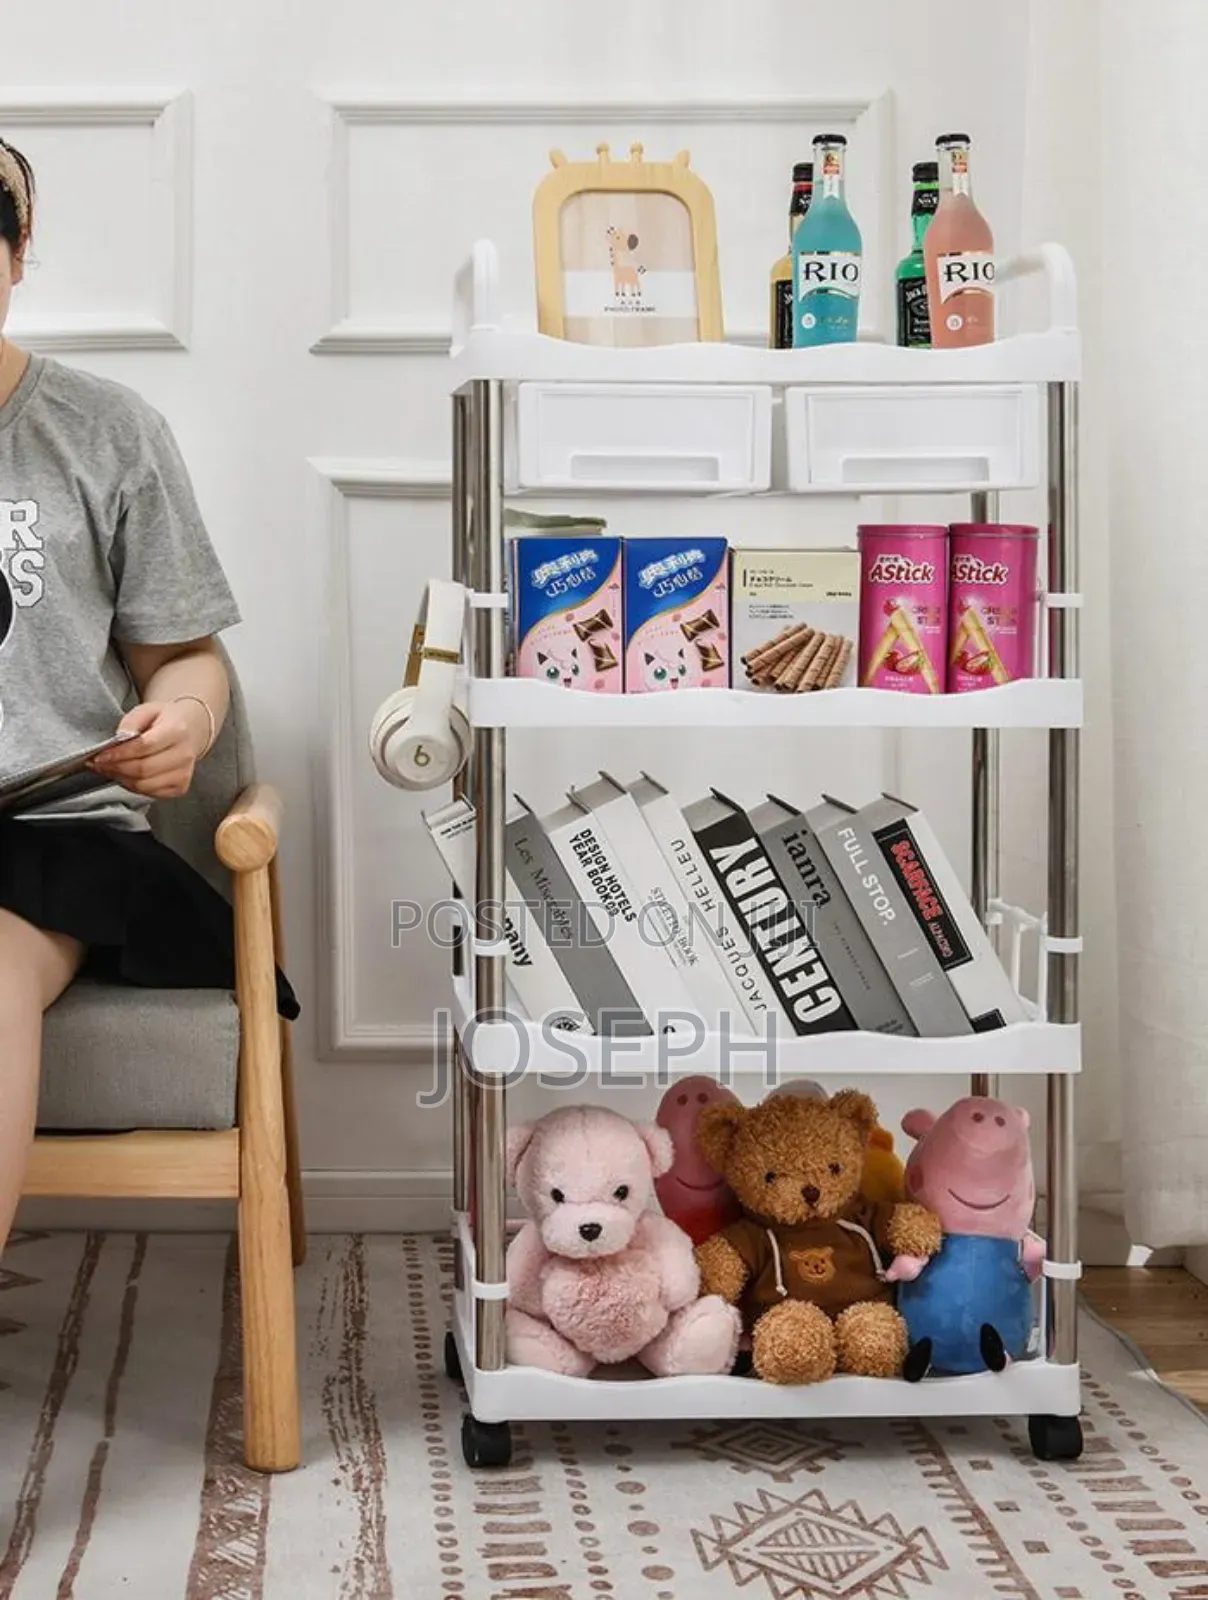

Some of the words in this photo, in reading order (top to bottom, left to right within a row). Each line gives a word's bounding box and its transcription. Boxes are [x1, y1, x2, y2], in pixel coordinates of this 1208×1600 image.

[803, 262, 859, 282] RIO
[944, 262, 995, 282] RIO
[569, 833, 593, 868] YEAR
[579, 828, 611, 874] DESIGN
[604, 874, 637, 922] HOTELS
[670, 838, 717, 912] HELLEU
[837, 827, 869, 875] FULL
[862, 874, 896, 926] STOP.
[709, 837, 841, 1023] CENTURY
[716, 926, 768, 1011] JACQUES
